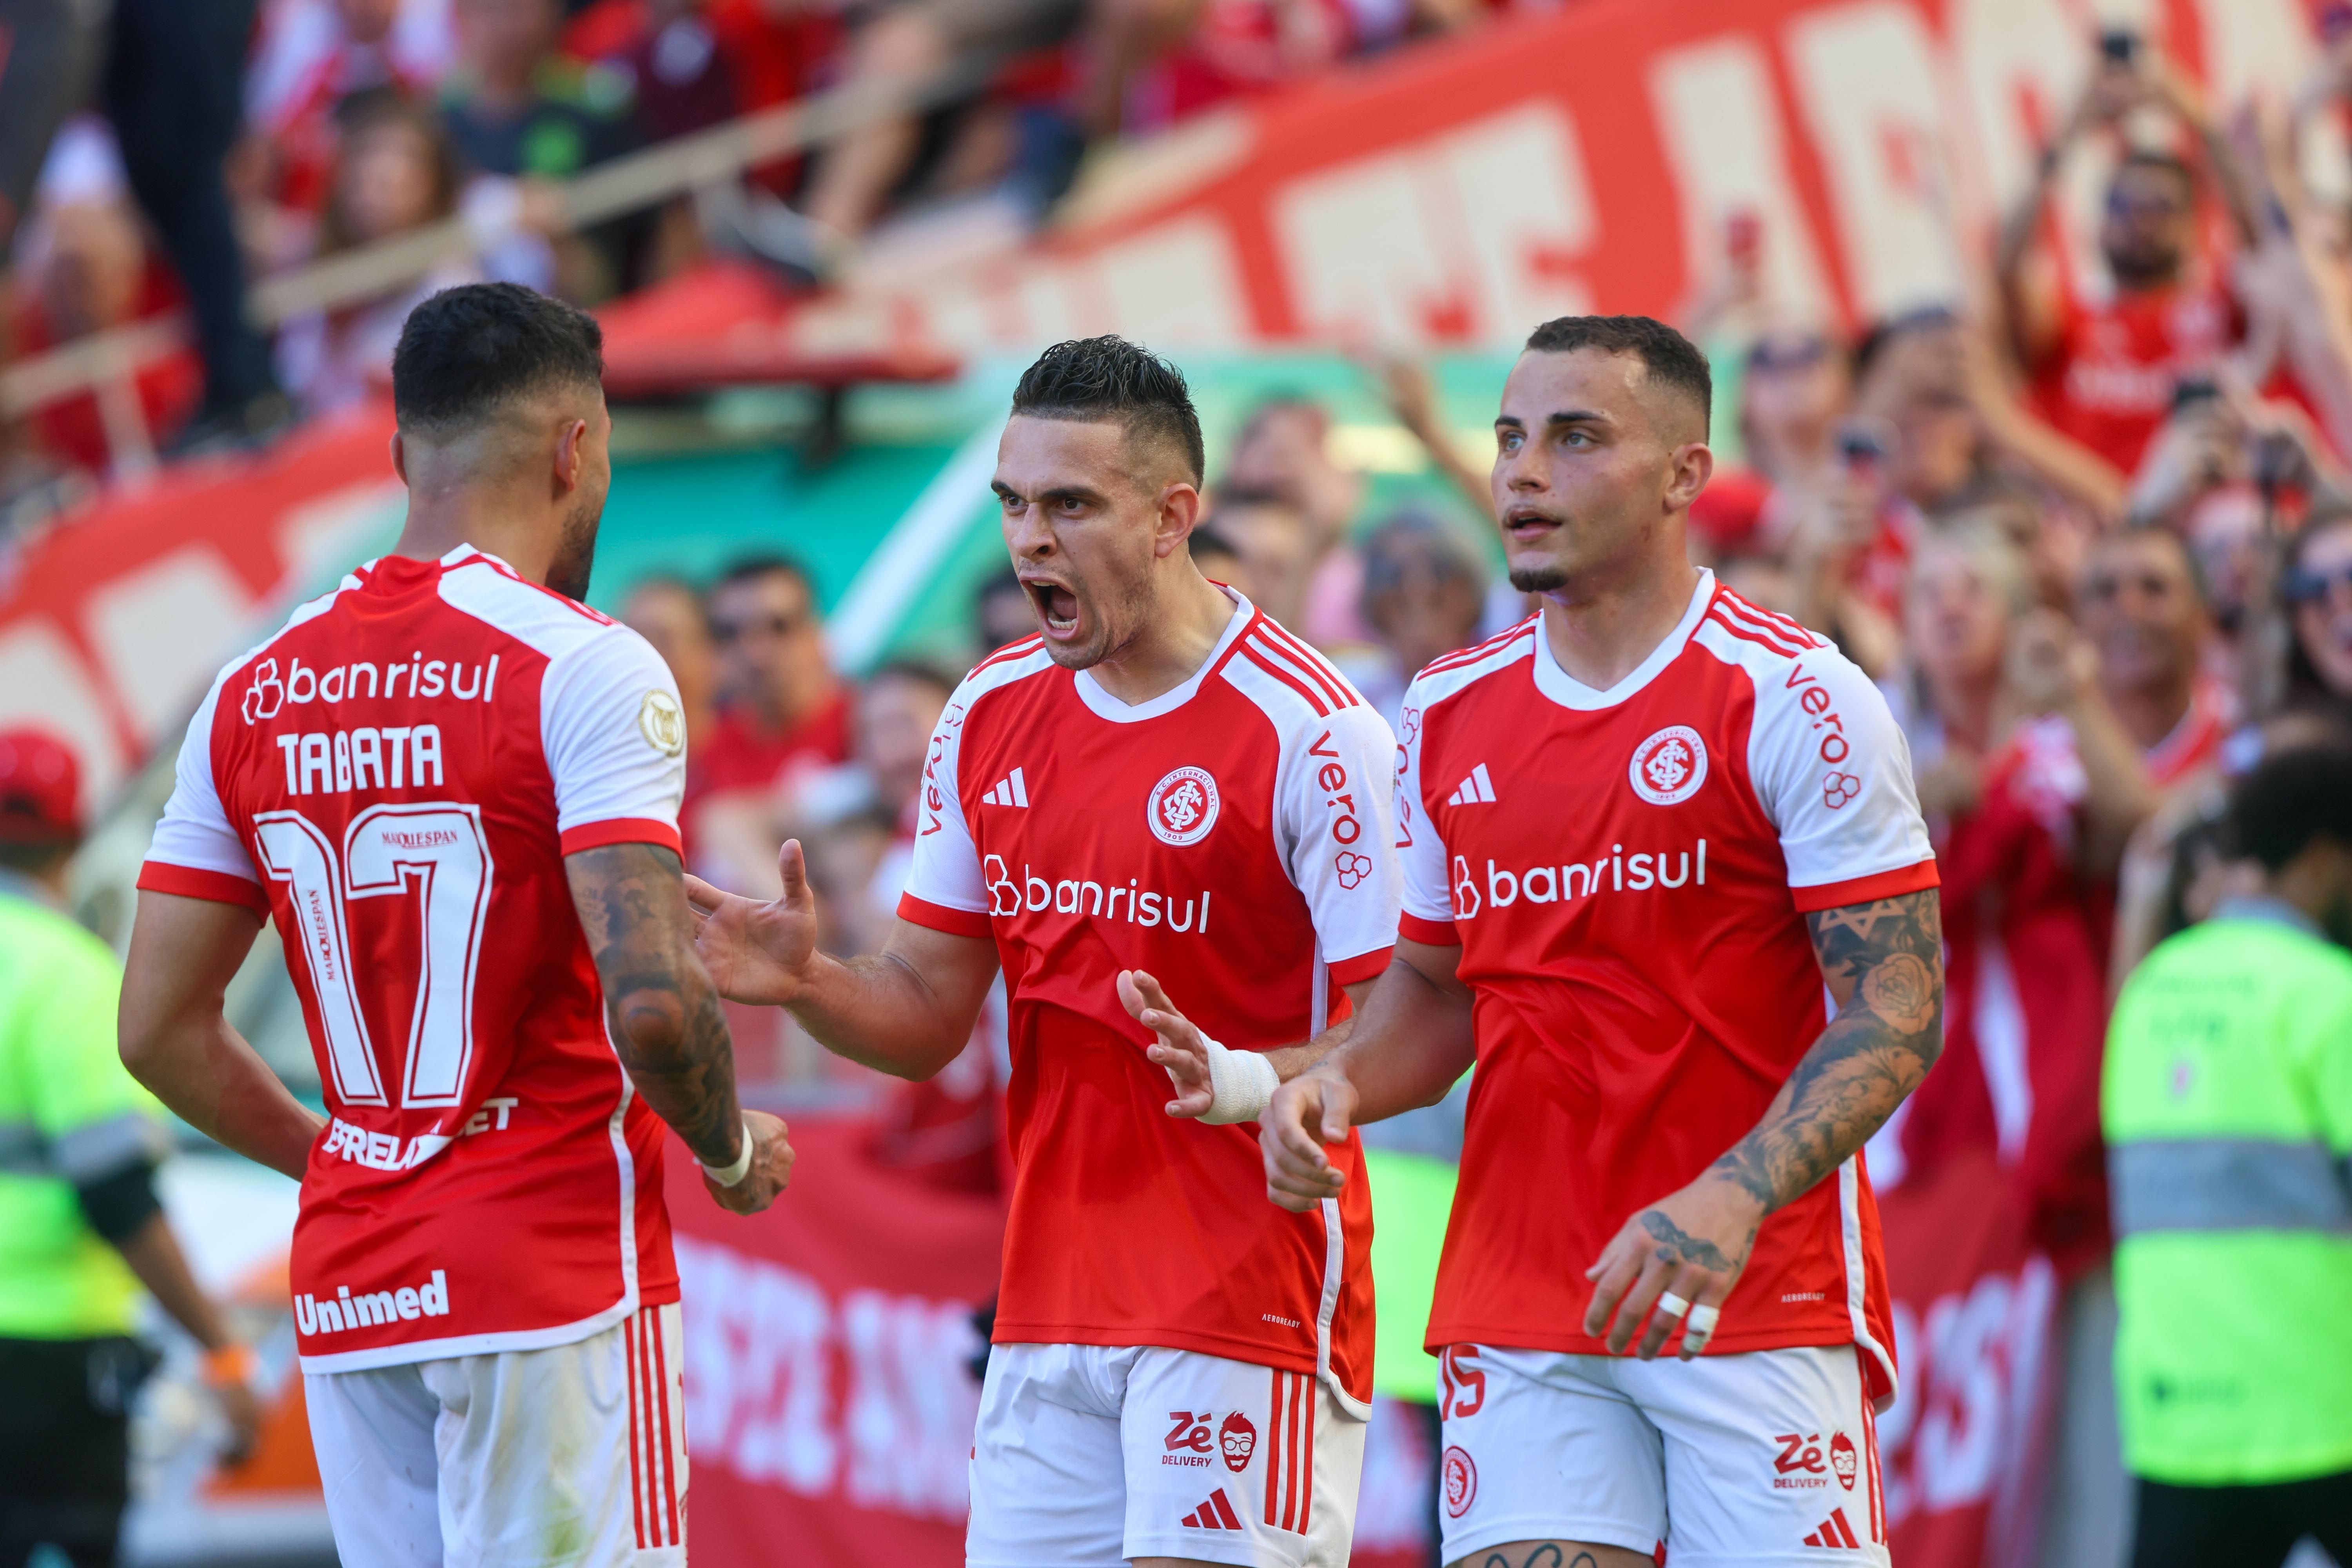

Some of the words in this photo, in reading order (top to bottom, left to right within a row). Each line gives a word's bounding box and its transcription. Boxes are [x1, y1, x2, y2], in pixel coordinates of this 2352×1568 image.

[287, 651, 499, 704] banrisul
[1785, 663, 1849, 763] vero
[277, 724, 443, 795] TABATA
[1308, 730, 1361, 844] vero
[1169, 771, 1215, 809] INTERNACIONAL
[1025, 864, 1210, 933] banrisul
[1488, 838, 1706, 907] banrisul
[252, 802, 494, 1109] 17
[294, 1269, 449, 1336] Unimed
[1262, 1314, 1300, 1328] AEROREADY
[1162, 1455, 1212, 1467] DELIVERY
[1164, 1411, 1214, 1453] Zé
[1774, 1433, 1827, 1475] Zé
[1774, 1478, 1828, 1488] DELIVERY
